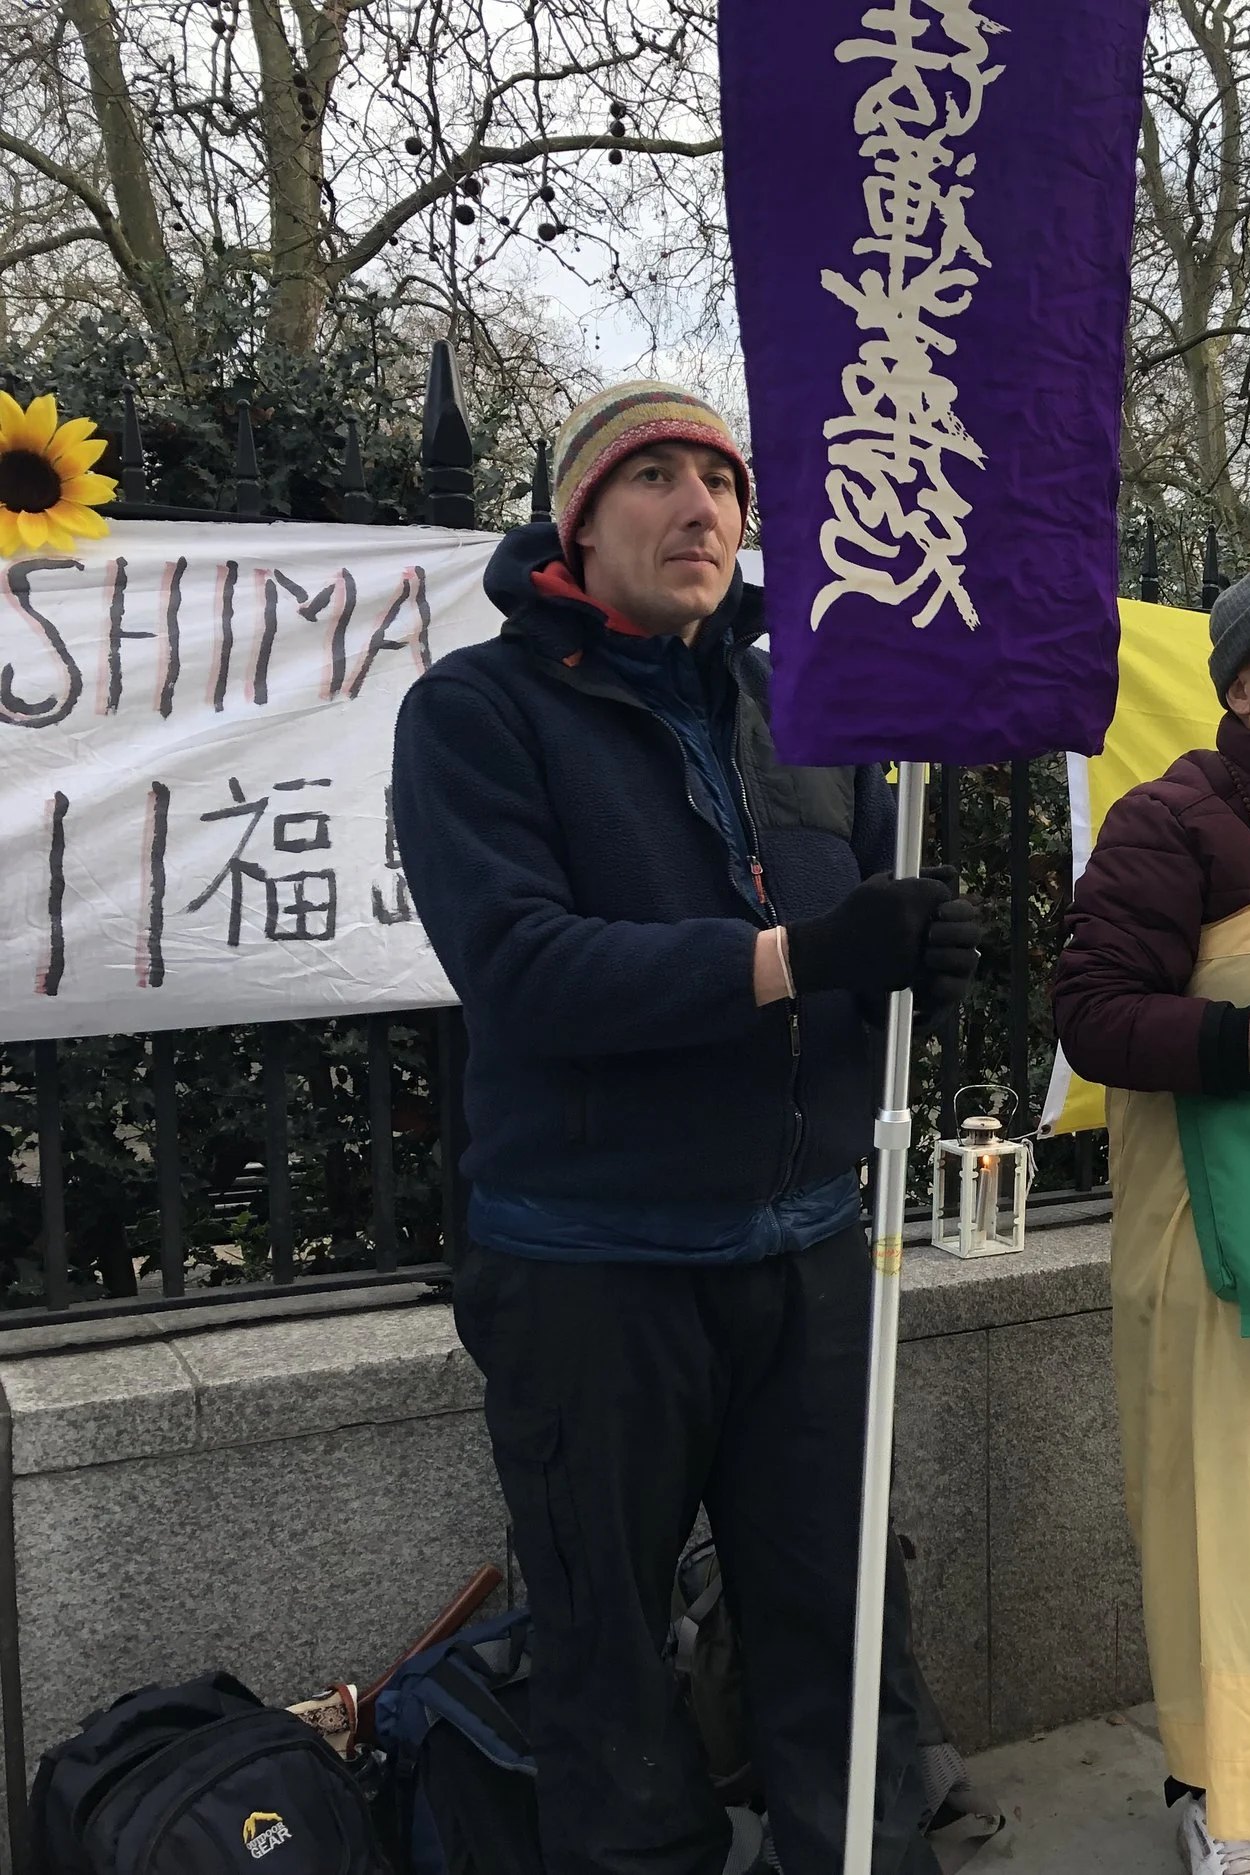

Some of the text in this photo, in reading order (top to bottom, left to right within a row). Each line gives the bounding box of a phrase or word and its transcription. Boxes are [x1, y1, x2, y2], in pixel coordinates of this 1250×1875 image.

[0, 556, 431, 728] SHIMA
[176, 777, 413, 946] 福
[246, 1821, 286, 1850] OUTDOOR
[251, 1827, 292, 1859] GEAR
